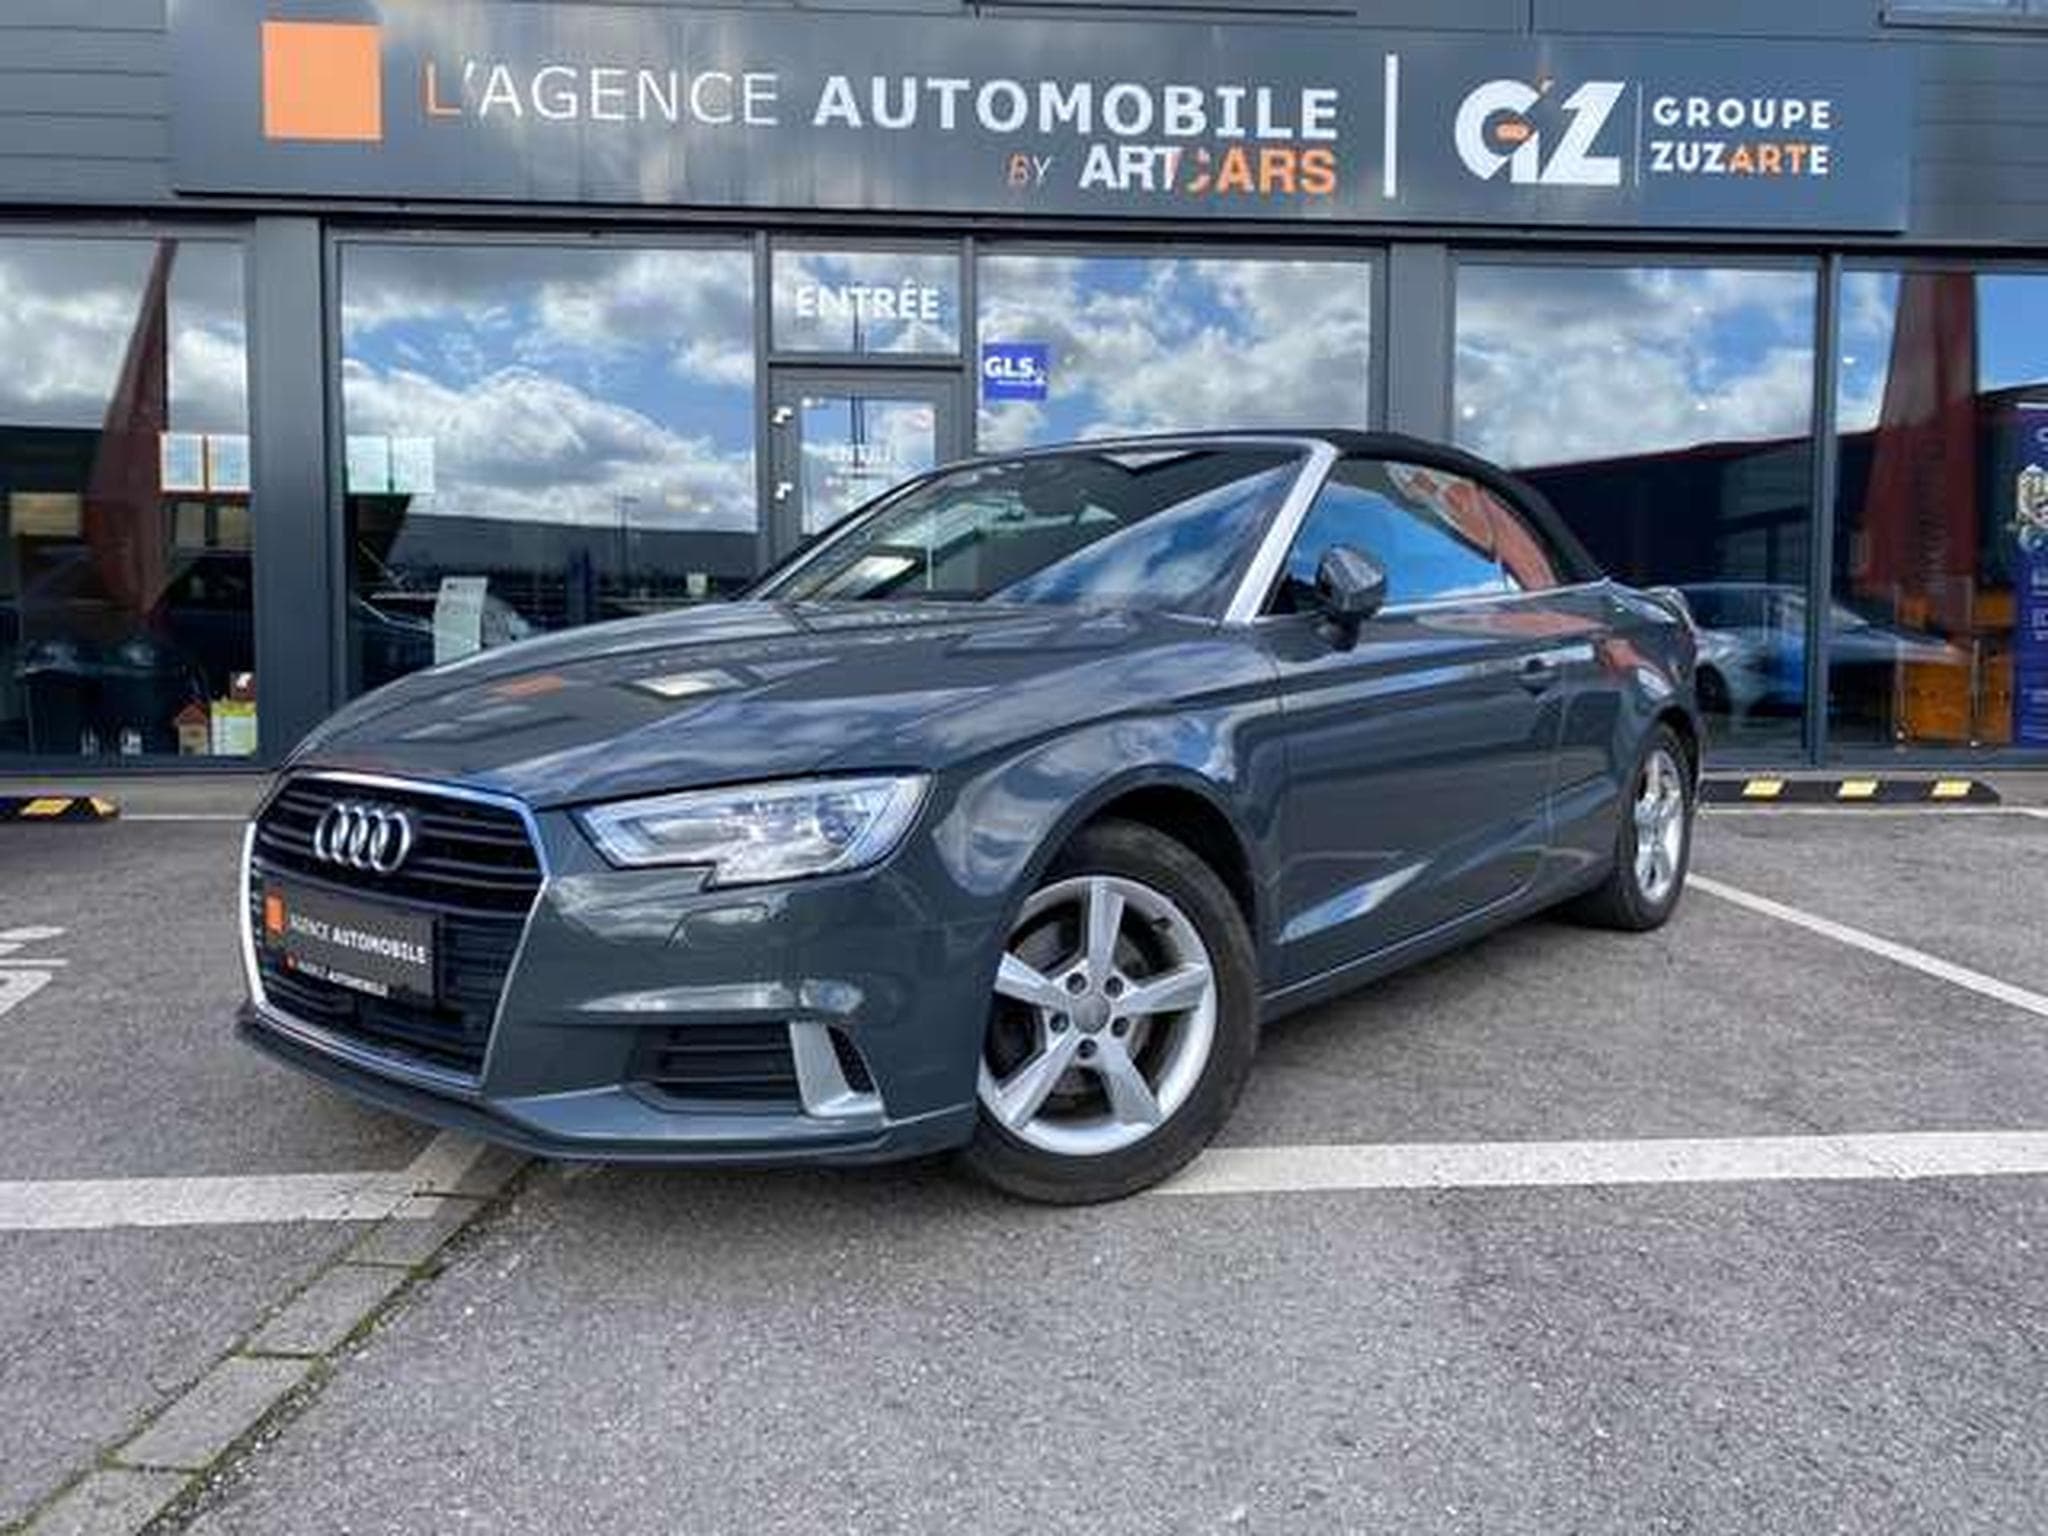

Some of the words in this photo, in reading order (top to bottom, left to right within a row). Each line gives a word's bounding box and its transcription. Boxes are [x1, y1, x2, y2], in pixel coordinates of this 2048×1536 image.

[423, 60, 779, 126] L'AGENCE
[812, 74, 1338, 140] AUTOMOBILE
[1653, 96, 1831, 130] GROUPE
[1650, 140, 1830, 176] ZUZARTE
[795, 278, 939, 320] ENTRÉE
